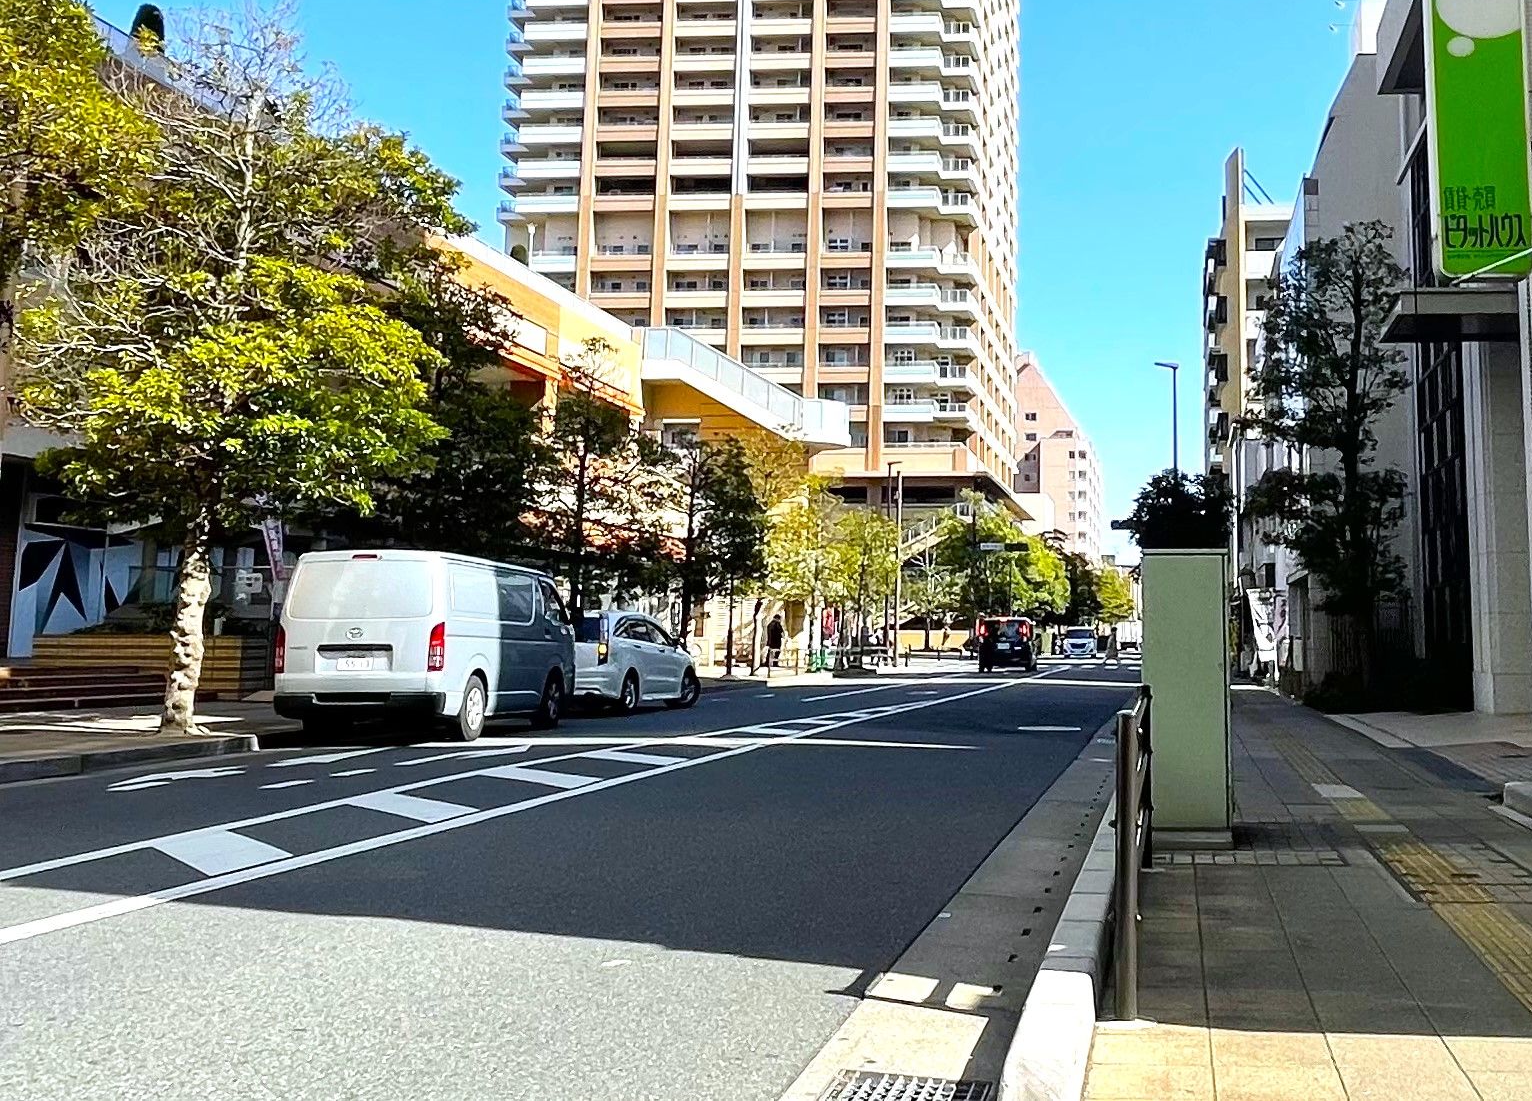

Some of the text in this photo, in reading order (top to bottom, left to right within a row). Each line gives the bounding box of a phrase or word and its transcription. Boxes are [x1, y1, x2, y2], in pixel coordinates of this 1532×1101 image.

[1445, 213, 1526, 248] ピタットハウス
